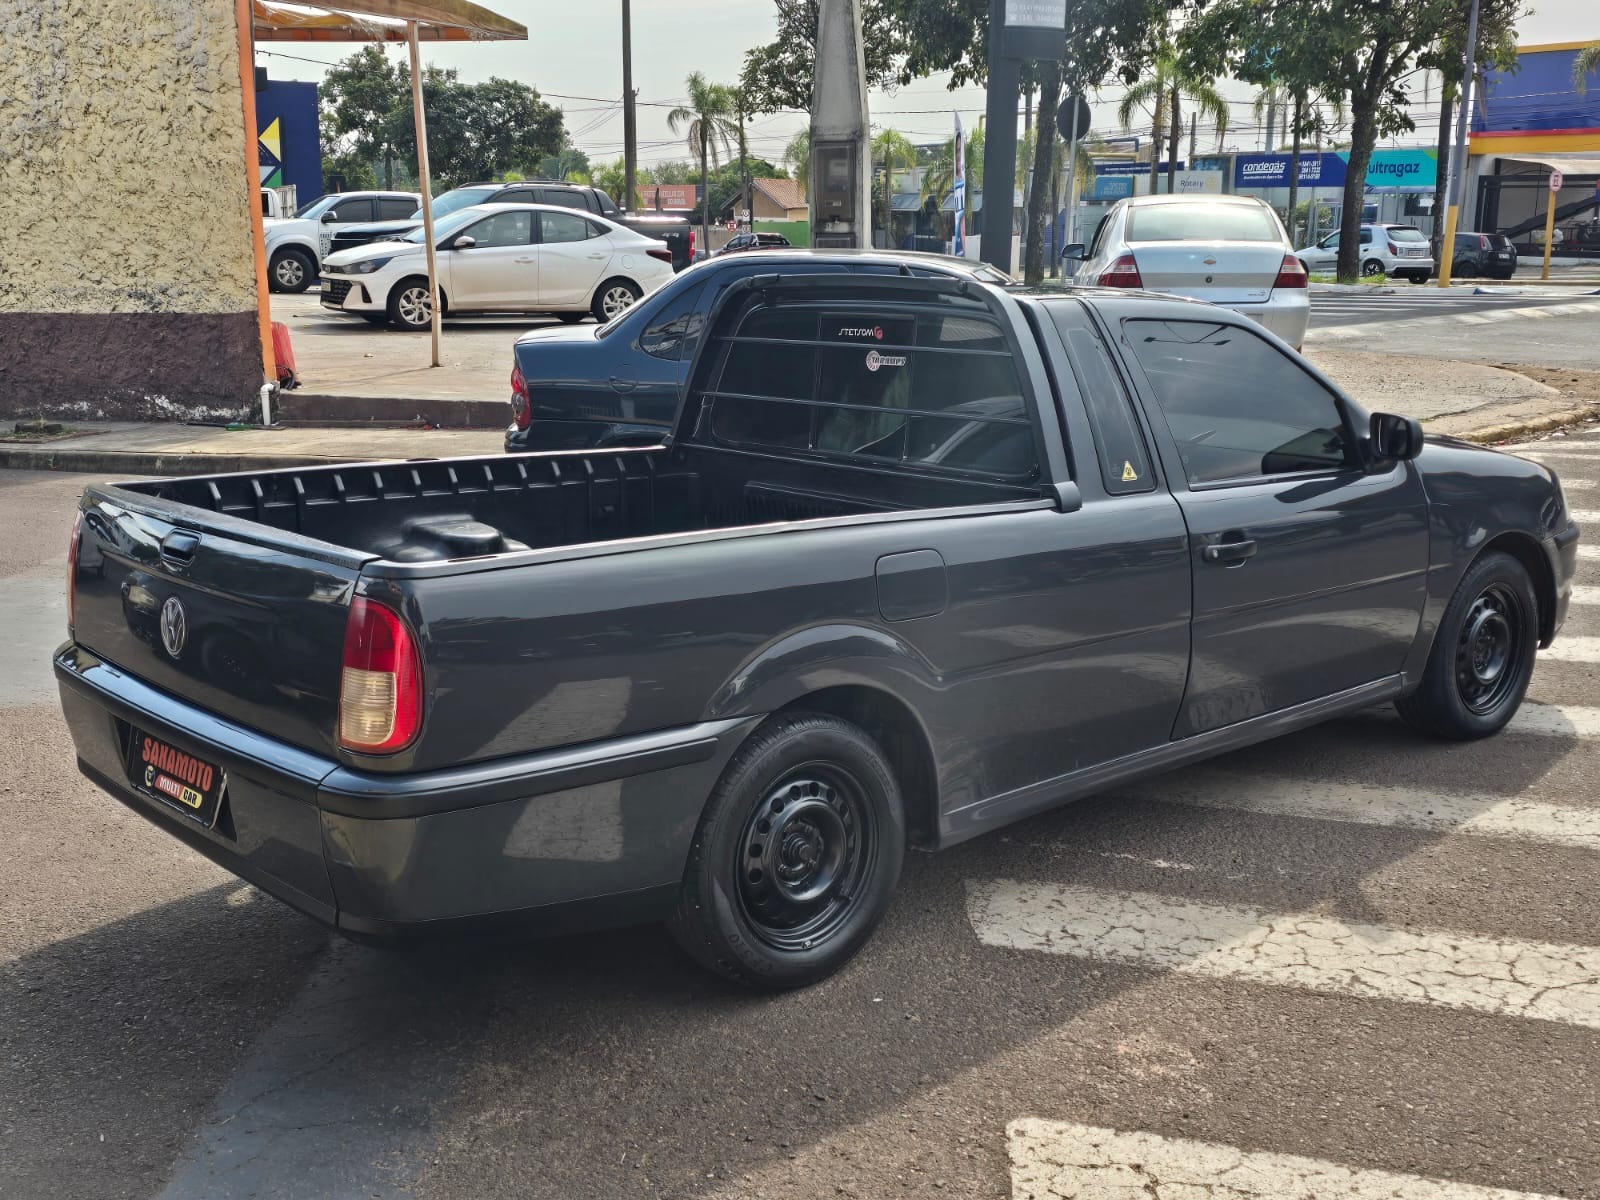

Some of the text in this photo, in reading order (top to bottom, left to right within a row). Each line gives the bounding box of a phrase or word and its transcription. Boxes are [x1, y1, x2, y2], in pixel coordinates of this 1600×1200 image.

[1368, 160, 1420, 178] ultragaz
[142, 737, 213, 792] SAKAMOTO
[159, 776, 198, 806] MULTI CAR
